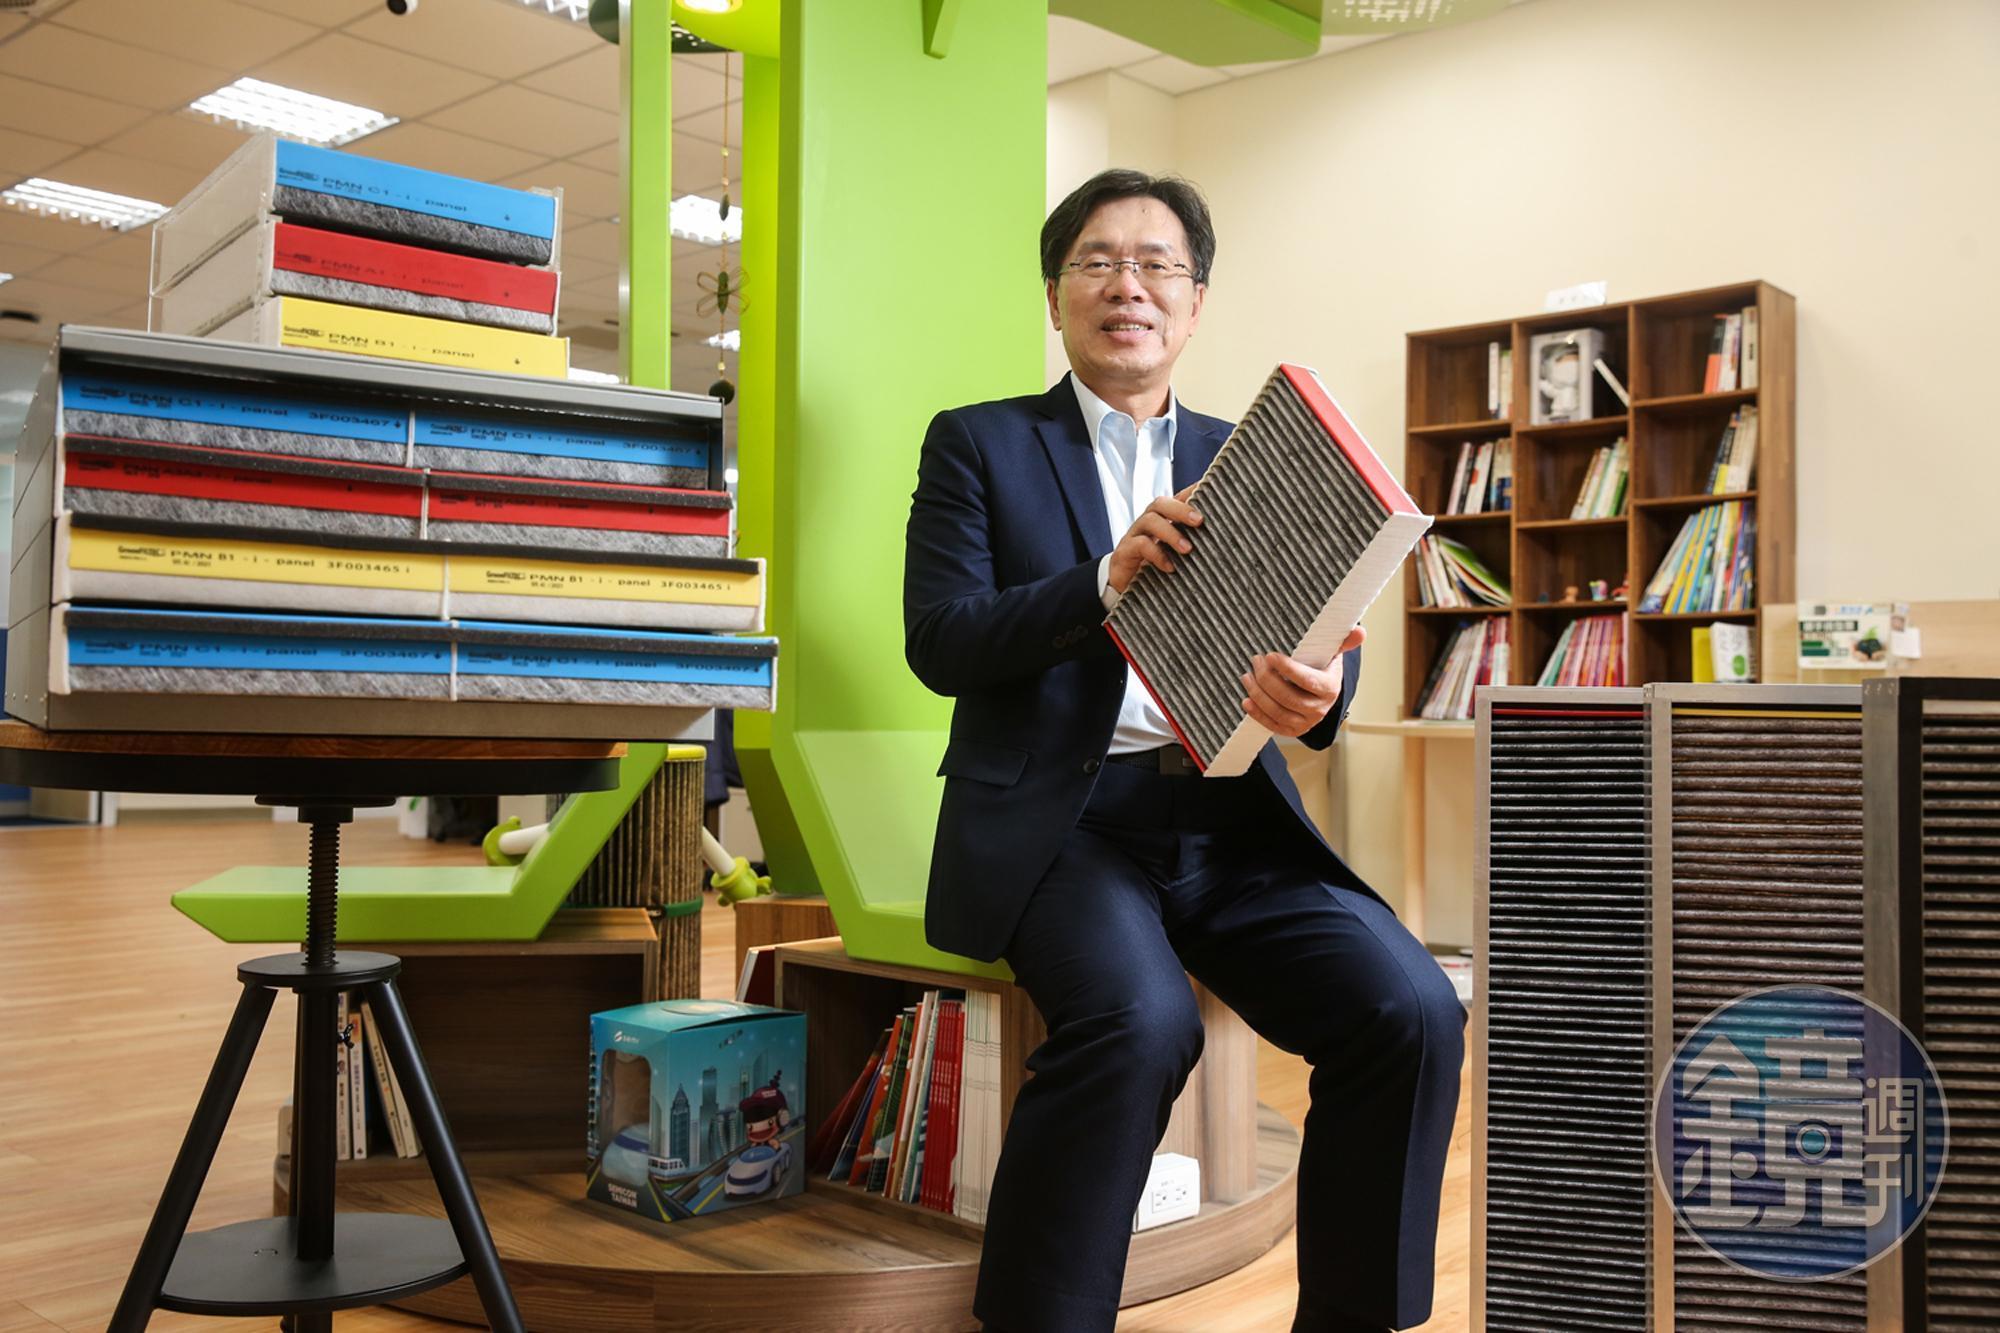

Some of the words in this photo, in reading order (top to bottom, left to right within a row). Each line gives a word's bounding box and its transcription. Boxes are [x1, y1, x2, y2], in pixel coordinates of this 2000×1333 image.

[171, 550, 212, 559] PMN
[218, 553, 235, 561] B1
[276, 558, 315, 568] panel
[327, 561, 400, 573] 3F003465
[529, 574, 565, 582] PMN
[569, 575, 583, 583] B1
[618, 579, 650, 588] panel
[661, 581, 722, 590] 3F003465
